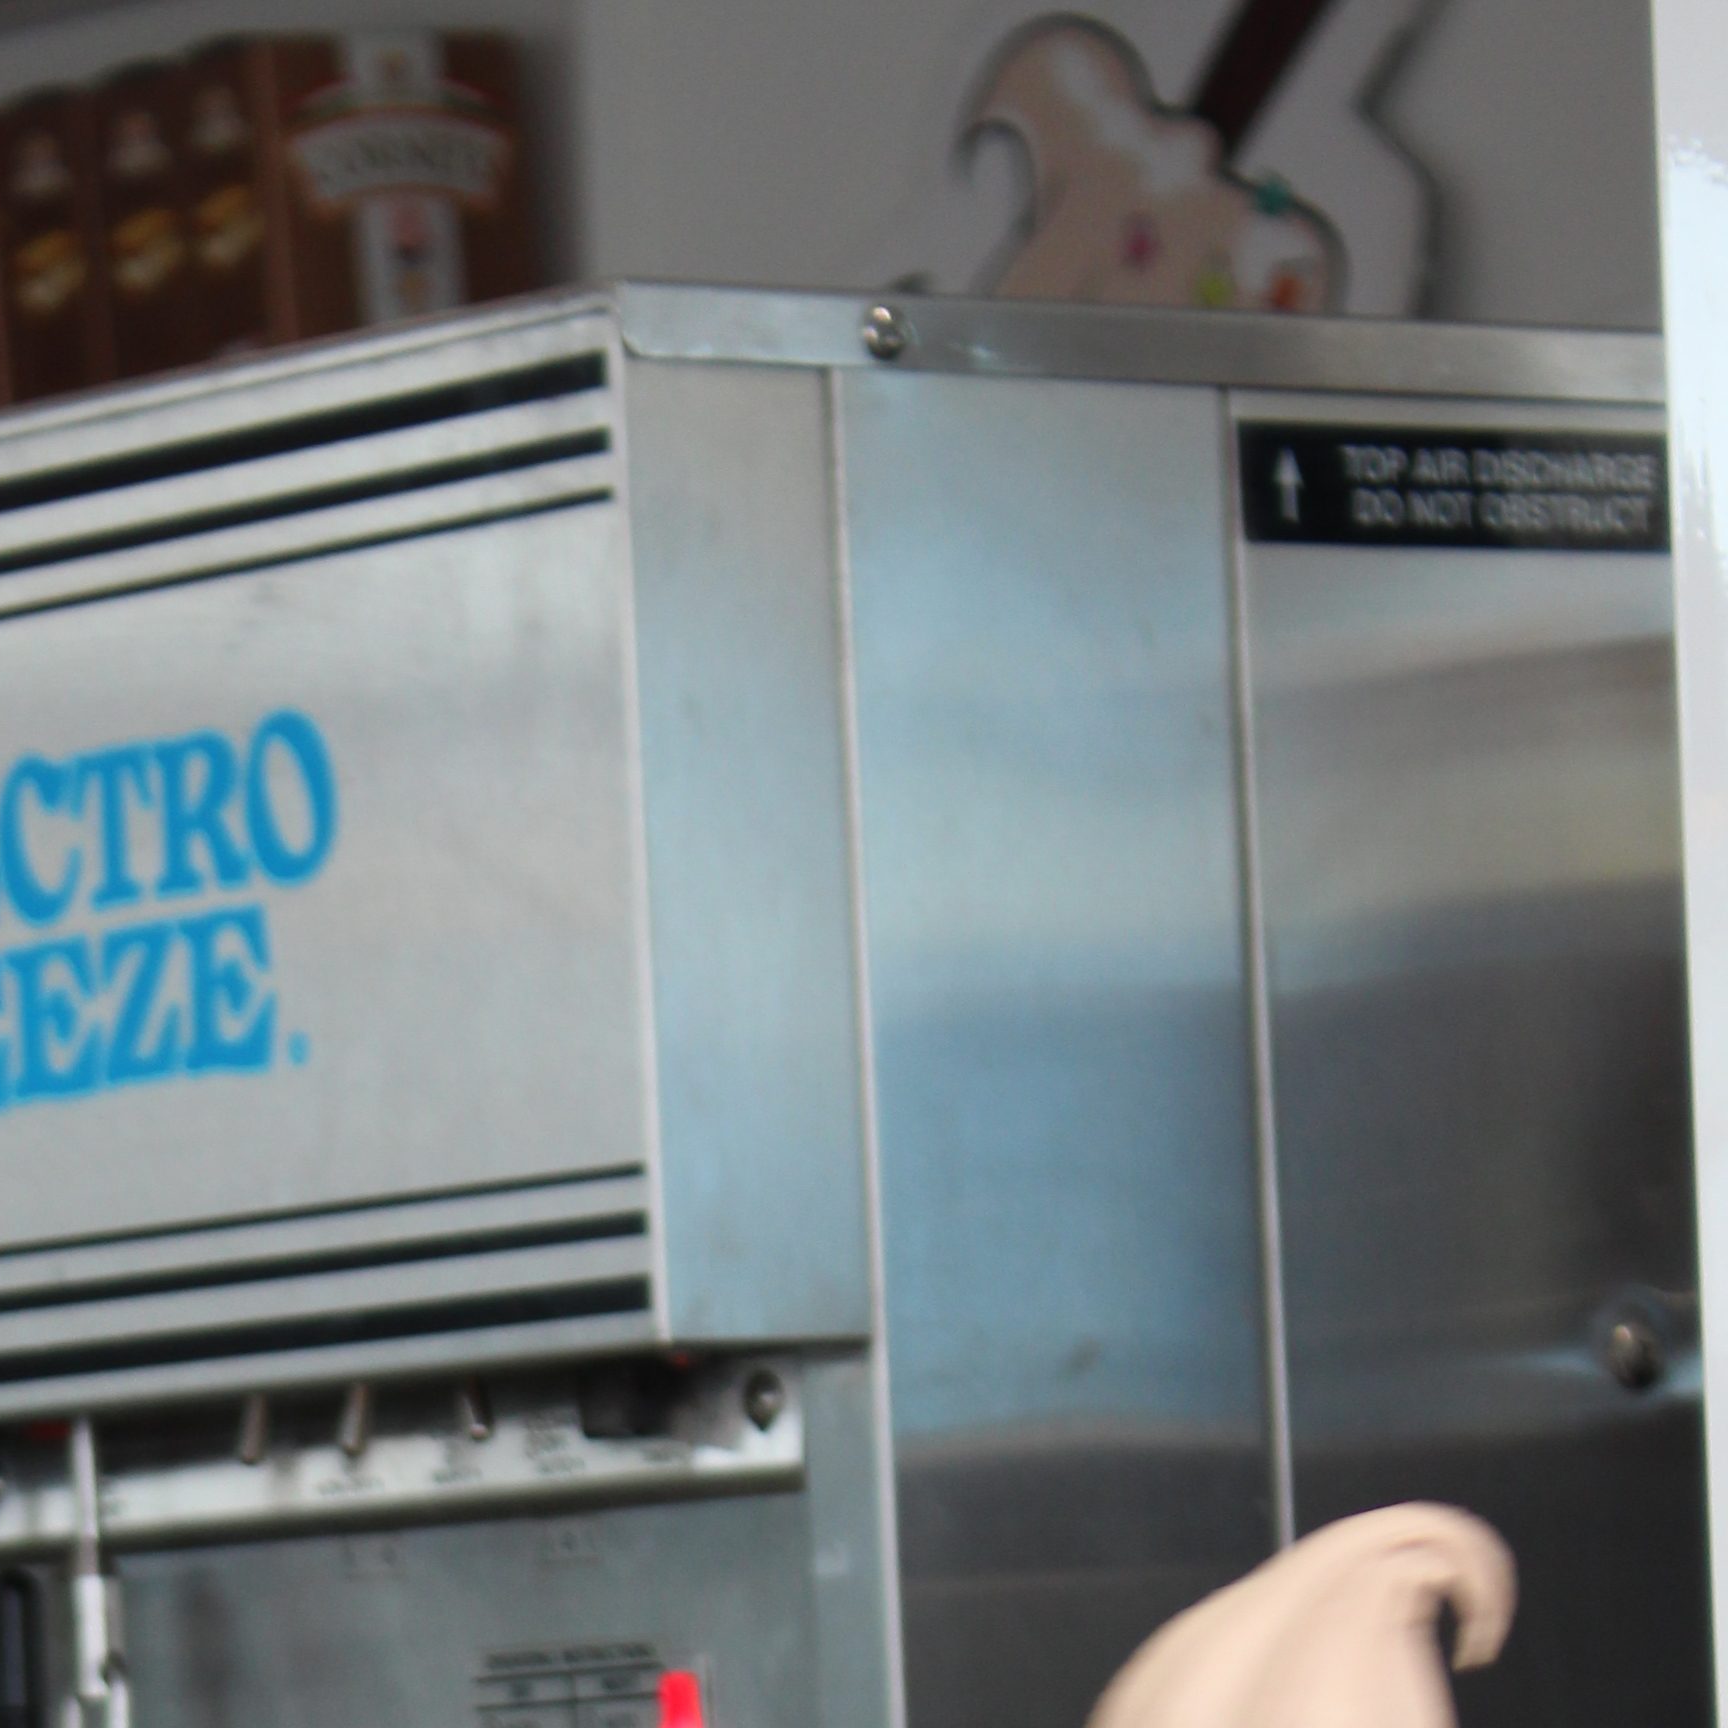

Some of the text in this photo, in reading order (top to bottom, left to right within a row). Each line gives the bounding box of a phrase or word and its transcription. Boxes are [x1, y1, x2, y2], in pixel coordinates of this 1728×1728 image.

[1339, 444, 1659, 493] TOP AIR DISCHARGE
[1351, 488, 1650, 534] DO NOT OBSTRUCT
